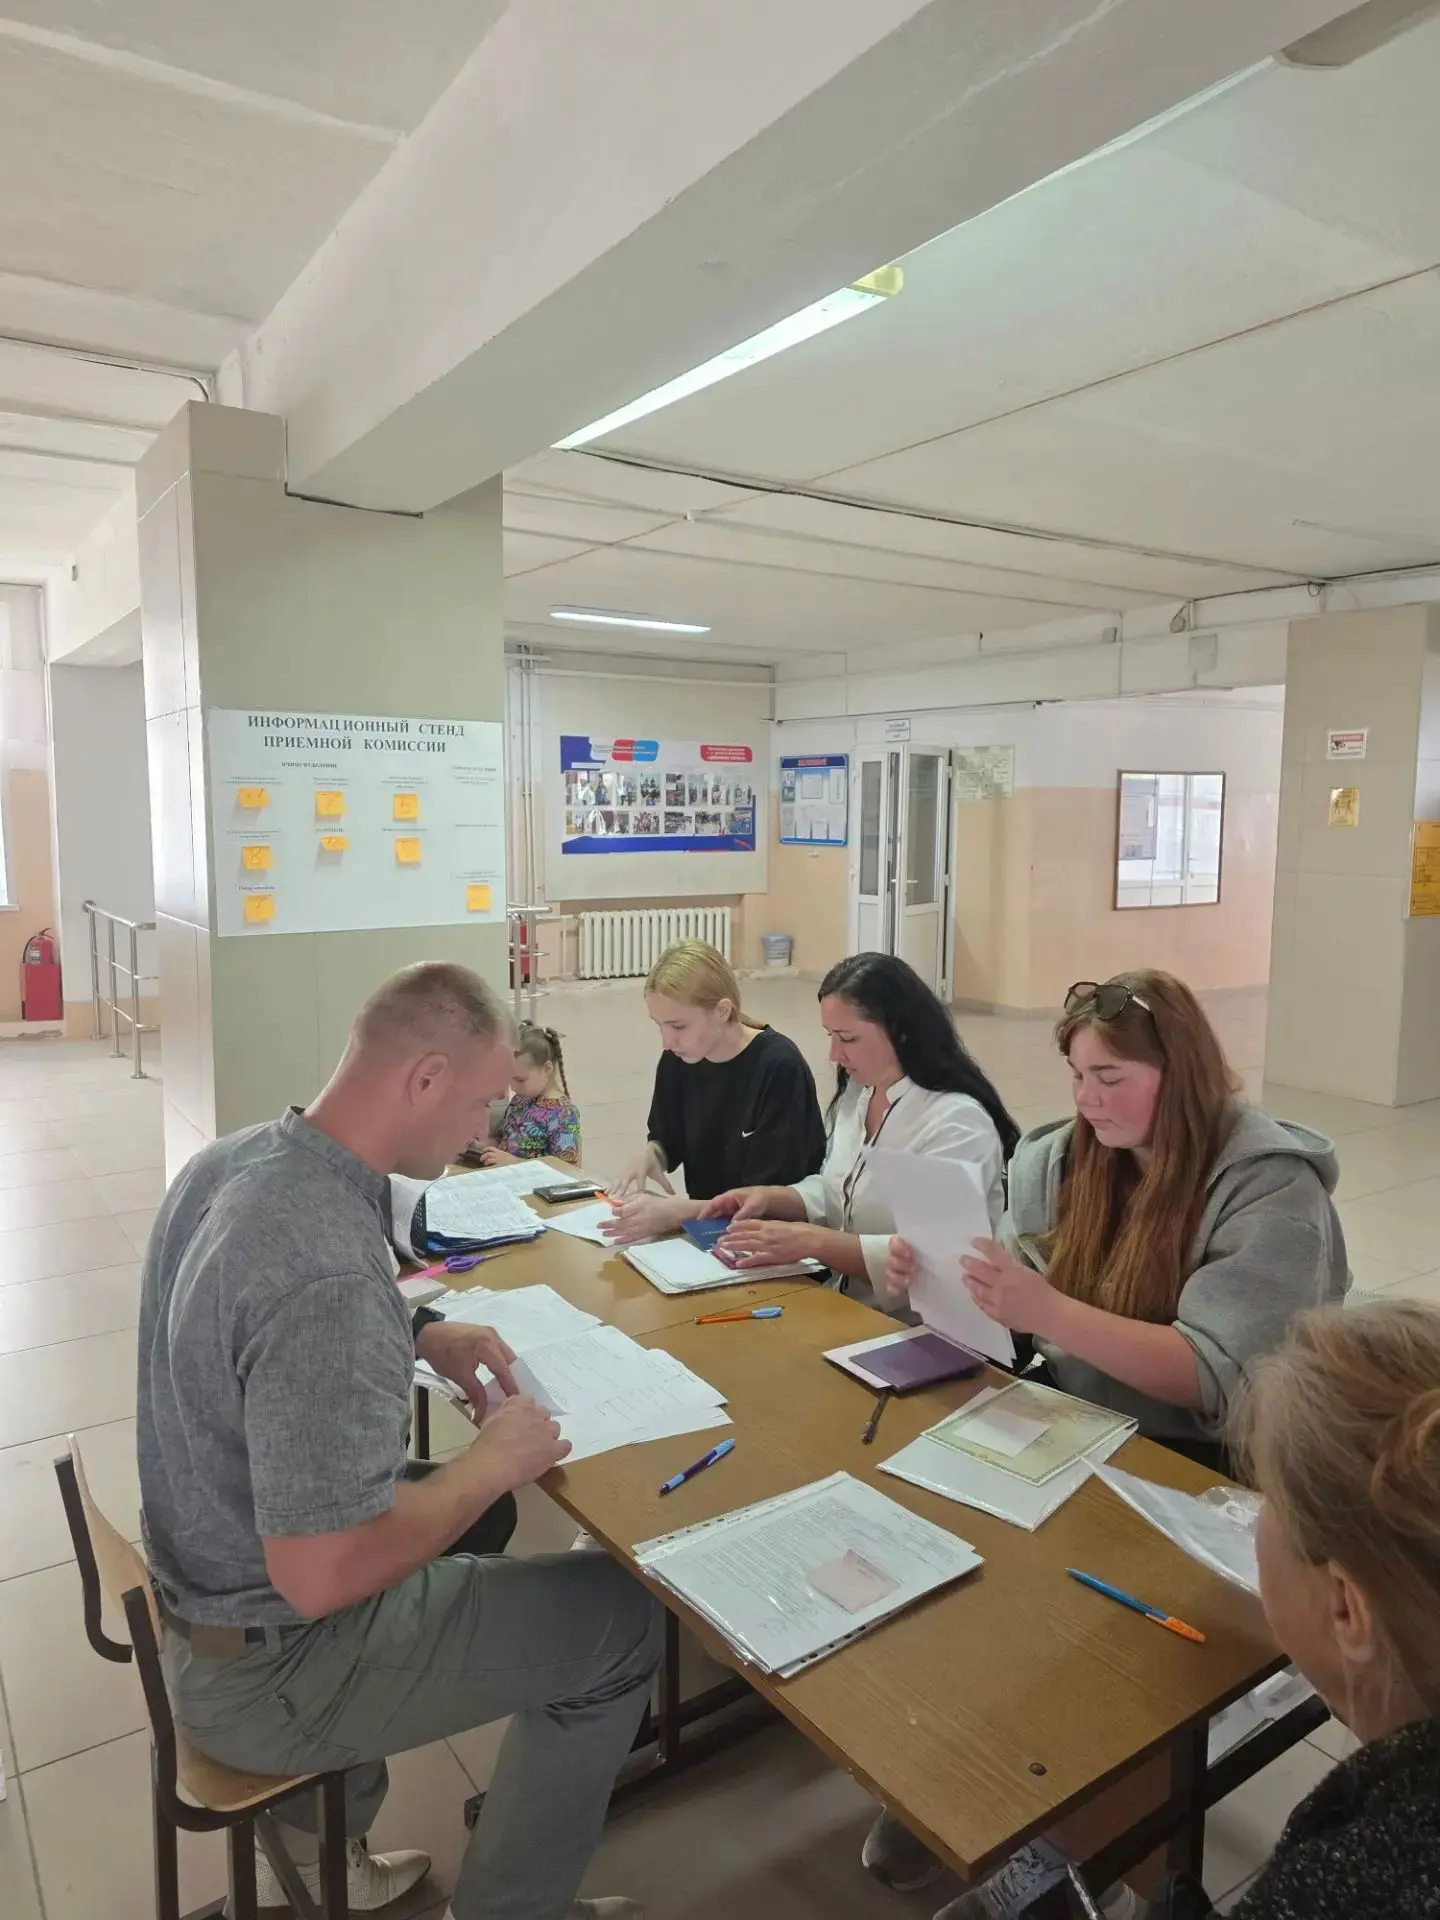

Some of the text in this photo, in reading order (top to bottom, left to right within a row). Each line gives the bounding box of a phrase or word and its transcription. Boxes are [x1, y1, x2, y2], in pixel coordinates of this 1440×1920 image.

[248, 715, 465, 737] ИНФОРМАЦИОННЫЙ СТЕНД
[263, 735, 446, 752] ПРИЕМНОЙ КОМИССИИ
